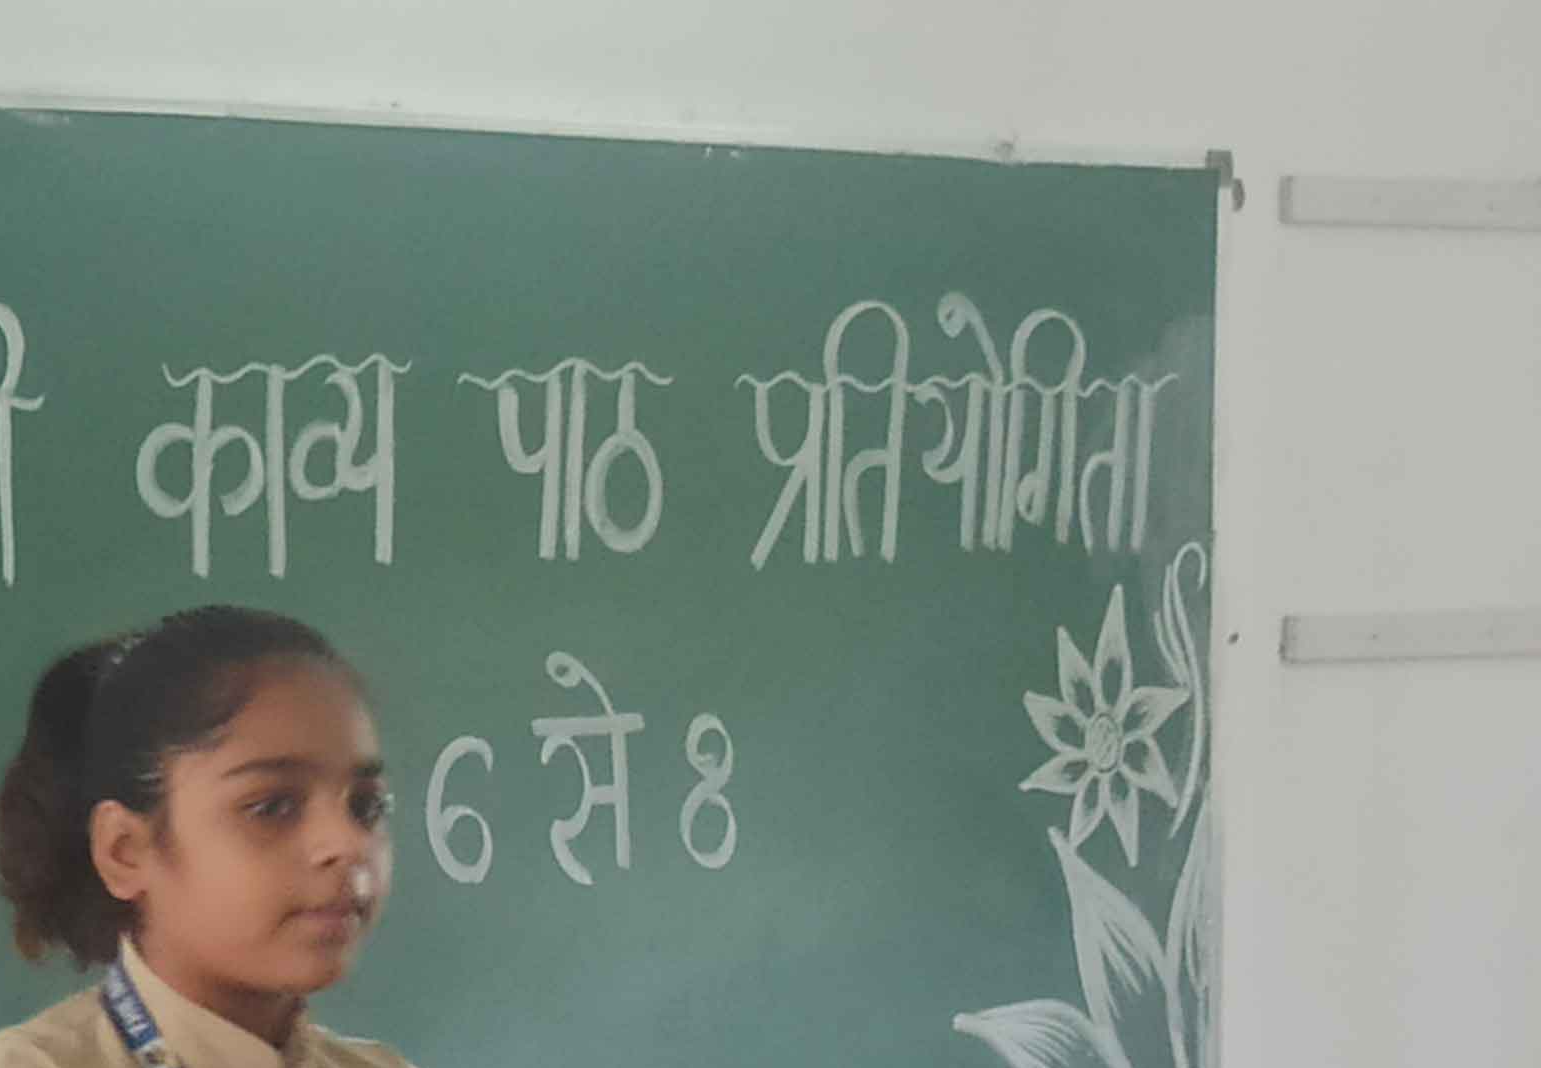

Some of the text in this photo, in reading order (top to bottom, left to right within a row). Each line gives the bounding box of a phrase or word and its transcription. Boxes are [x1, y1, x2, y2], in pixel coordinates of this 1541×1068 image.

[136, 354, 411, 578] काव्य
[458, 357, 673, 560] पाठ
[734, 292, 1178, 572] प्रतियोगिता
[426, 735, 493, 883] 6
[532, 651, 645, 886] से
